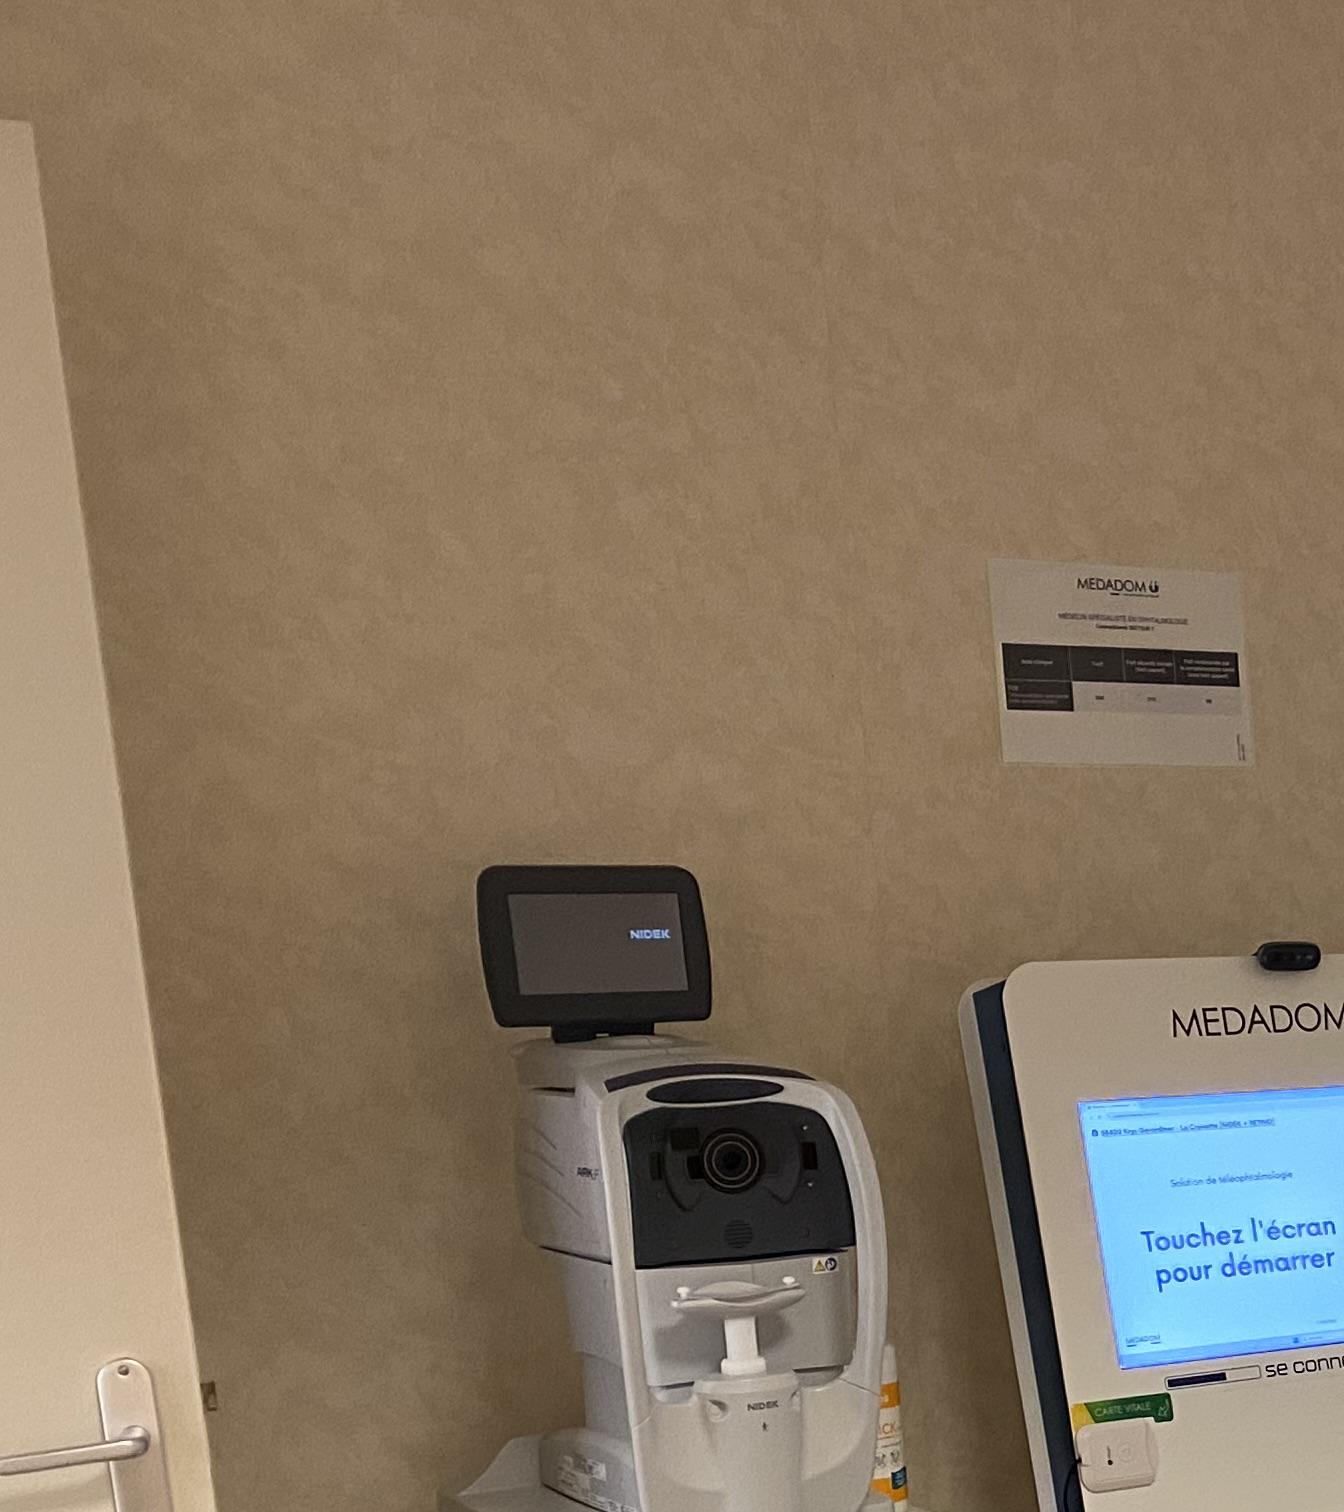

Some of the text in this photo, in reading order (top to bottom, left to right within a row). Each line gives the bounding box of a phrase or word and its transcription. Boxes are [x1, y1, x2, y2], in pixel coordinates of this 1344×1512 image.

[1077, 577, 1147, 592] MEDADOM
[629, 928, 671, 940] NIDEK
[1170, 1178, 1204, 1188] Solution
[1206, 1176, 1217, 1185] de
[1141, 1216, 1337, 1254] Touchez l'écran
[1155, 1249, 1336, 1293] pour démarrer
[1265, 1362, 1288, 1378] se
[1094, 1402, 1151, 1418] CARTE VITALE
